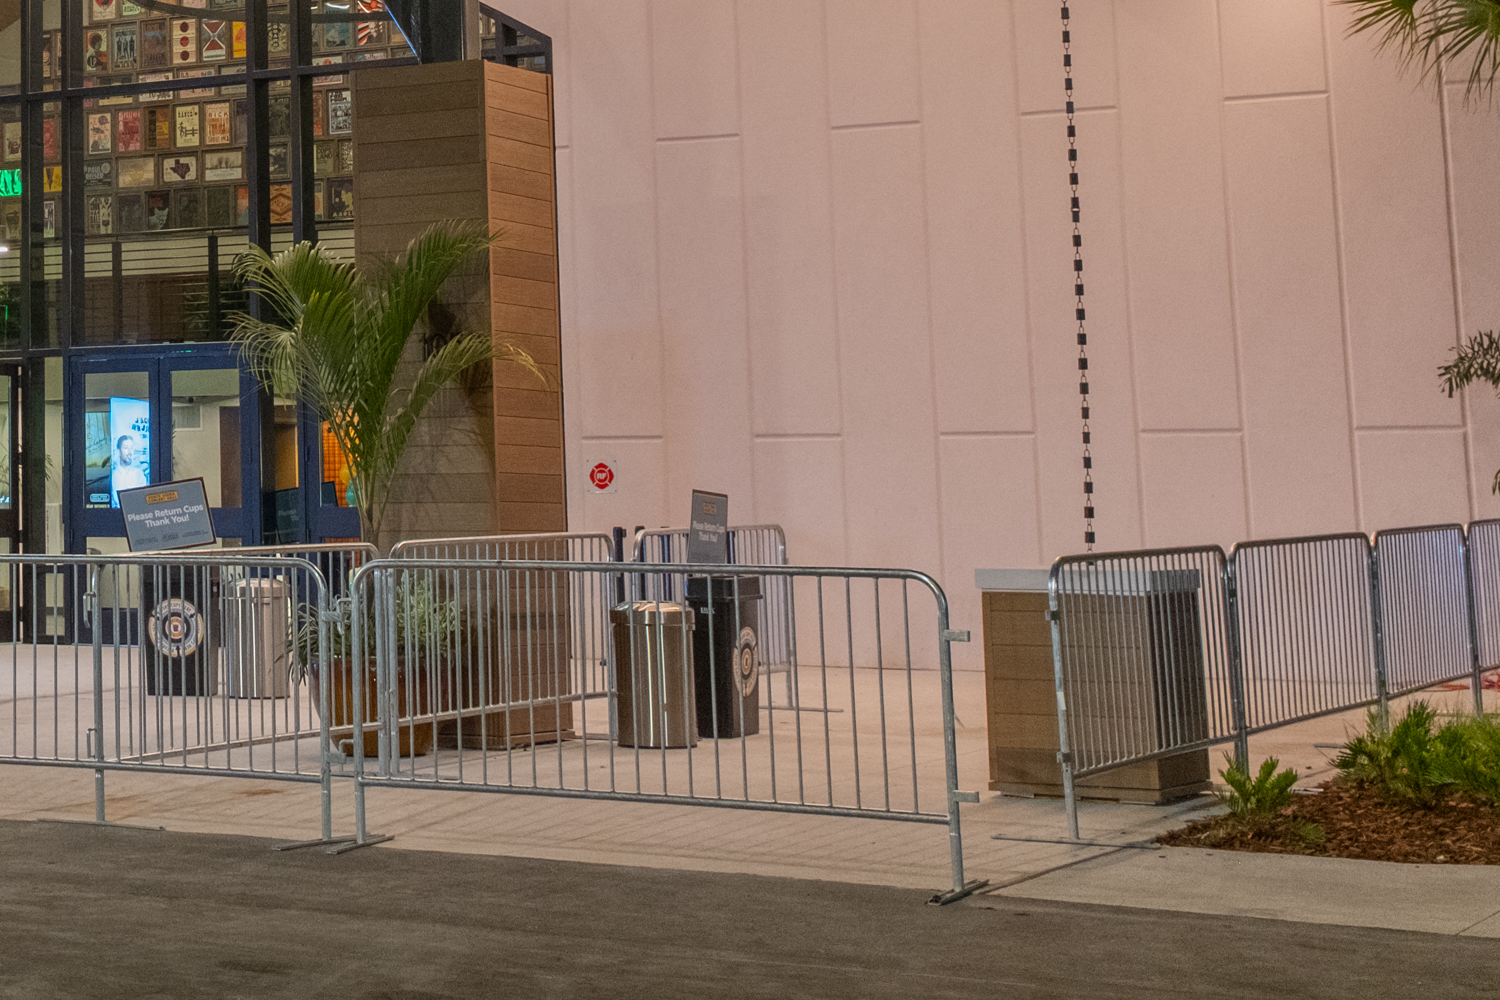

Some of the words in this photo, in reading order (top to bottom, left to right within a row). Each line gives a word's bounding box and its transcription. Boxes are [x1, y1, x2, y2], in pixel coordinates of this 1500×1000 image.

[128, 510, 153, 522] Please
[155, 507, 182, 518] Return
[183, 504, 204, 514] Cups
[145, 517, 170, 527] Thank
[171, 514, 190, 523] You!
